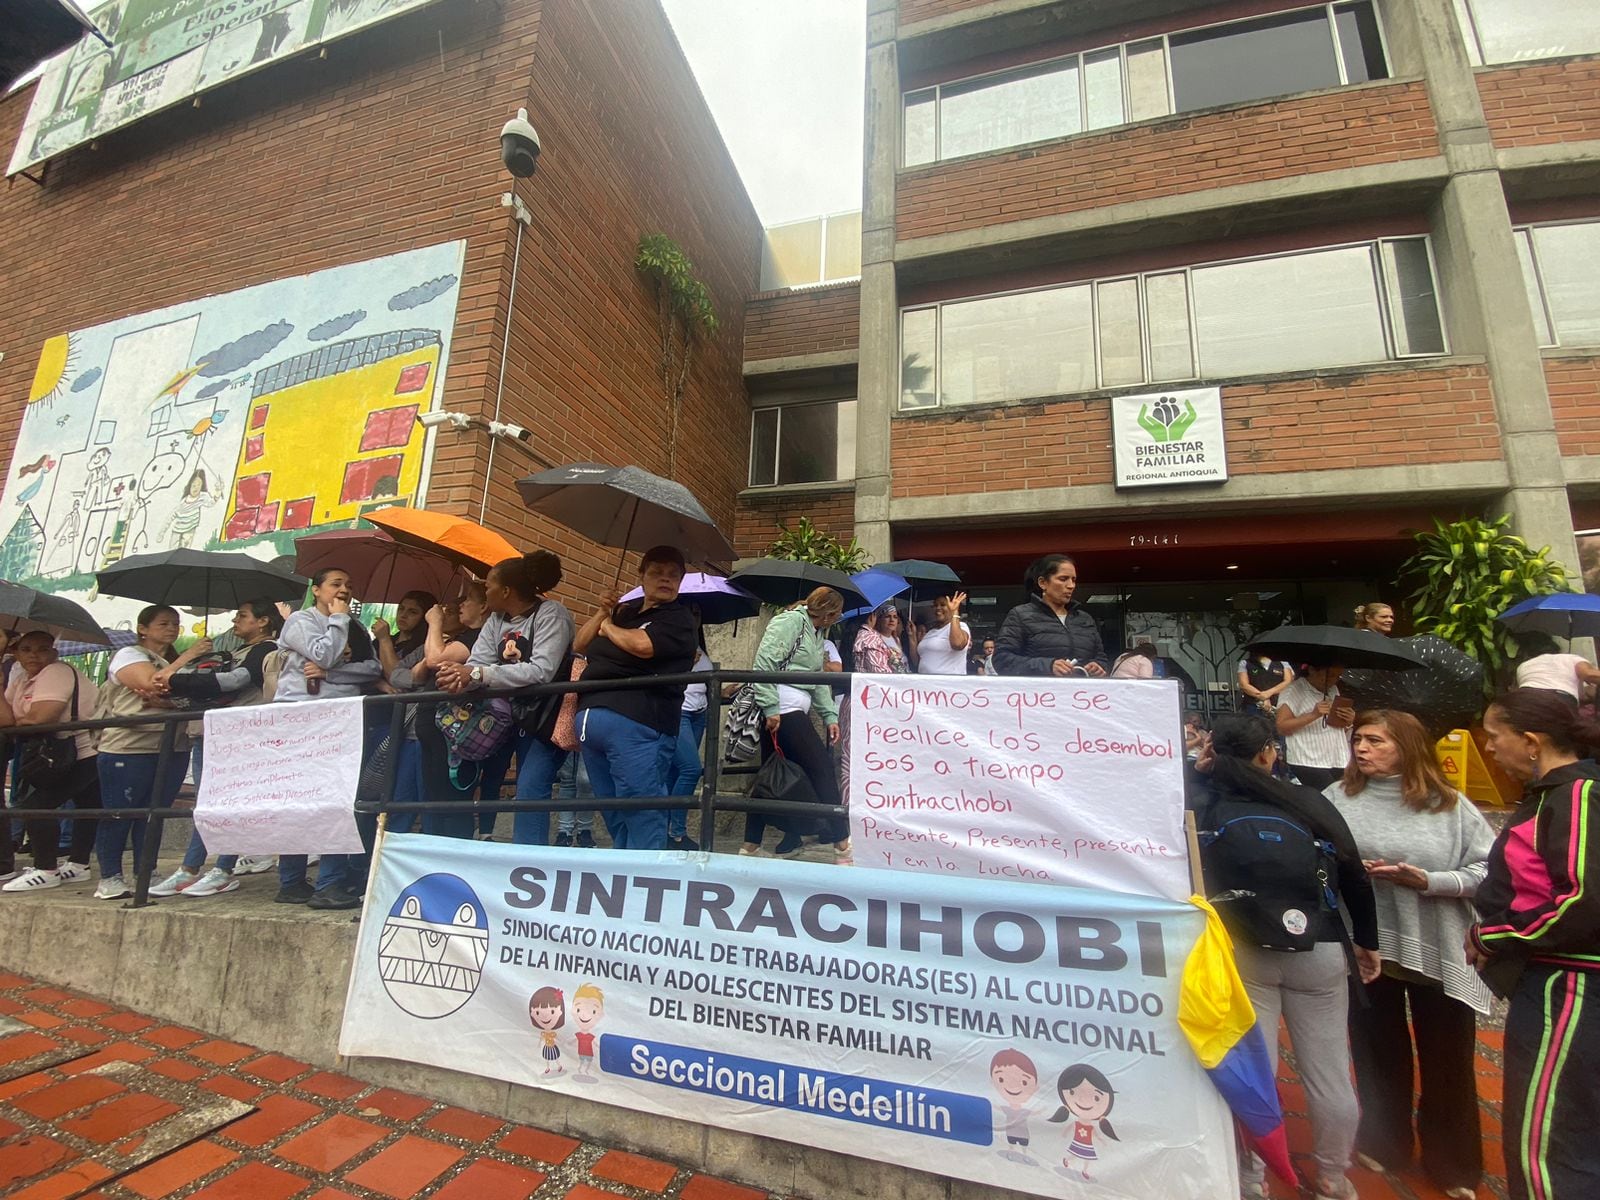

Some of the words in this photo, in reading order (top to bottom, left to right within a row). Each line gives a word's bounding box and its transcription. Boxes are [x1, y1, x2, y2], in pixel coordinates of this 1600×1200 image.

[1135, 441, 1204, 456] BIENESTAR
[1136, 454, 1205, 467] FAMILIAR
[1126, 473, 1167, 481] REGIONAL
[1169, 468, 1218, 477] ANTIOQUIA
[861, 685, 990, 722] Exigimos
[1006, 689, 1056, 729] que
[866, 722, 969, 747] realice
[1065, 728, 1173, 759] desembol
[934, 760, 951, 775] a
[963, 757, 1064, 788] tiempo
[865, 781, 1012, 812] Sintracihobi
[861, 817, 957, 848] Presente,
[905, 857, 928, 868] en
[503, 866, 1168, 978] SINTRACIHOBI
[501, 919, 598, 947] SINDICATO
[601, 930, 705, 962] NACIONAL
[710, 943, 738, 965] DE
[740, 946, 977, 999] TRABAJADORAS(ES)
[985, 976, 1018, 1001] AL
[1025, 979, 1164, 1018] CUIDADO
[500, 945, 523, 965] DE
[527, 949, 549, 969] LA
[554, 952, 643, 984] INFANCIA
[645, 966, 660, 985] Y
[661, 968, 833, 1012] ADOLESCENTES
[840, 990, 885, 1019] DEL
[892, 999, 1000, 1035] SISTEMA
[1011, 1014, 1166, 1057] NACIONAL
[649, 996, 688, 1022] DEL
[692, 1001, 810, 1041] BIENESTAR
[816, 1022, 933, 1061] FAMILIAR
[629, 1043, 785, 1102] Seccional
[798, 1072, 951, 1133] Medellín
